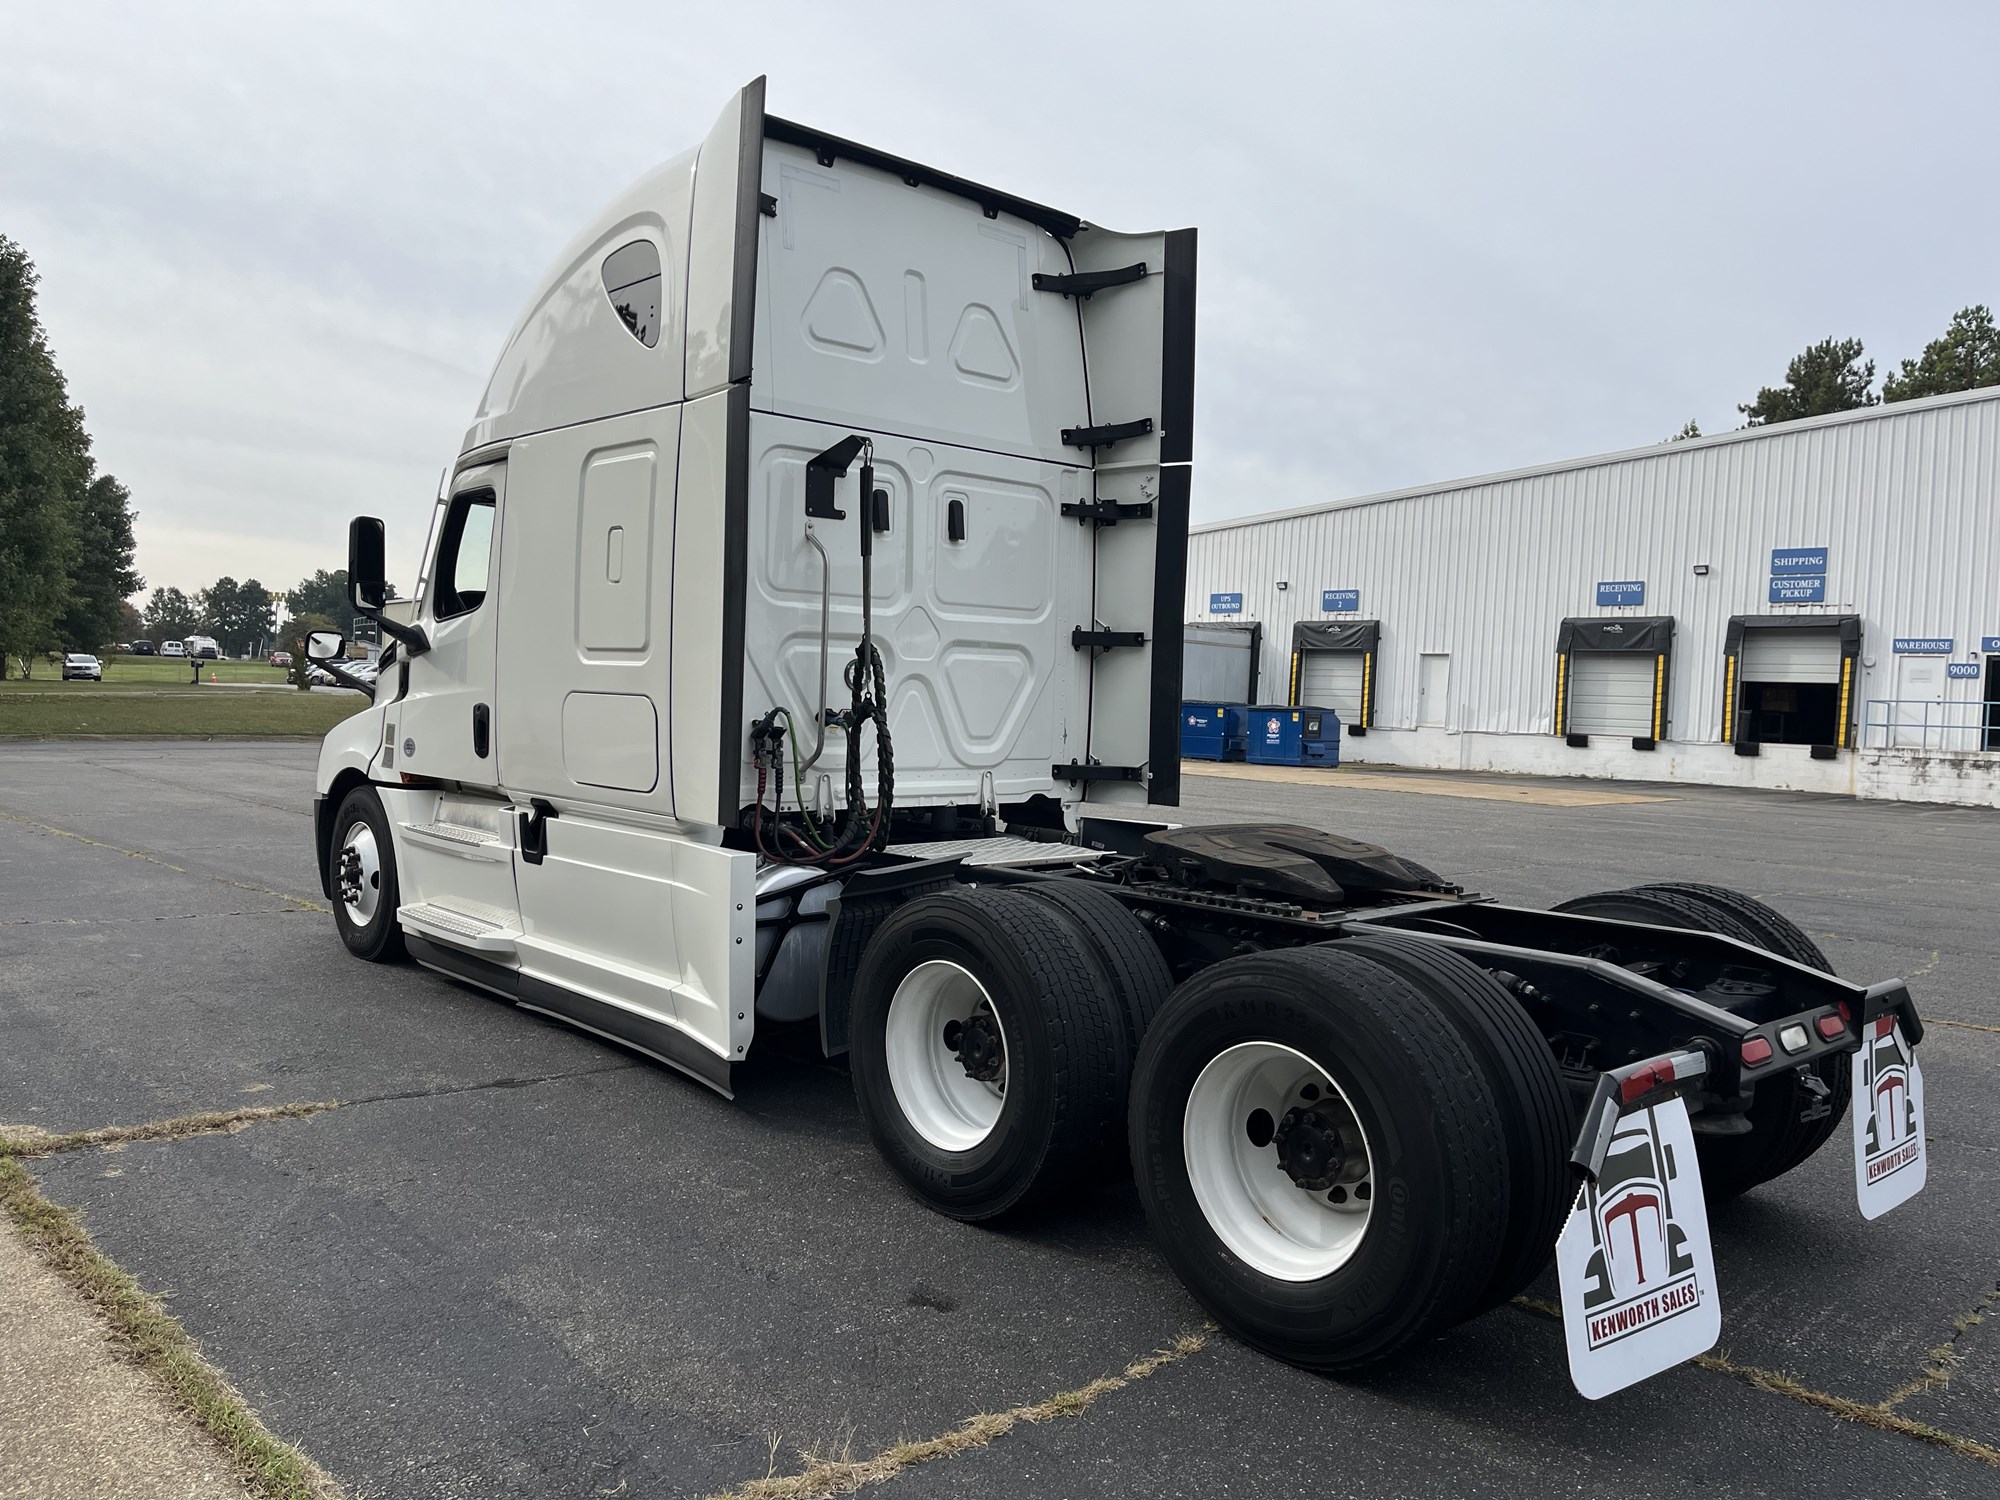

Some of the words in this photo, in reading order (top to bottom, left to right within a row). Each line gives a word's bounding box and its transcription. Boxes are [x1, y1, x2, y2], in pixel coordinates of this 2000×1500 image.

[1774, 556, 1824, 566] SHIPPING
[1599, 583, 1642, 593] RECEIVING
[1772, 579, 1821, 589] CUSTOMER
[1324, 592, 1357, 600] RECEIVING
[1617, 594, 1622, 602] 1
[1780, 588, 1813, 598] PICKUP
[1211, 602, 1240, 610] OUTBOUND
[1337, 600, 1343, 608] 2
[1895, 641, 1951, 650] WAREHOUSE
[1950, 665, 1978, 675] 9000
[1868, 1152, 1901, 1180] KENWORTH
[1902, 1142, 1917, 1162] SALES
[1591, 1297, 1660, 1342] KENWORTH
[1661, 1283, 1696, 1314] SALES
